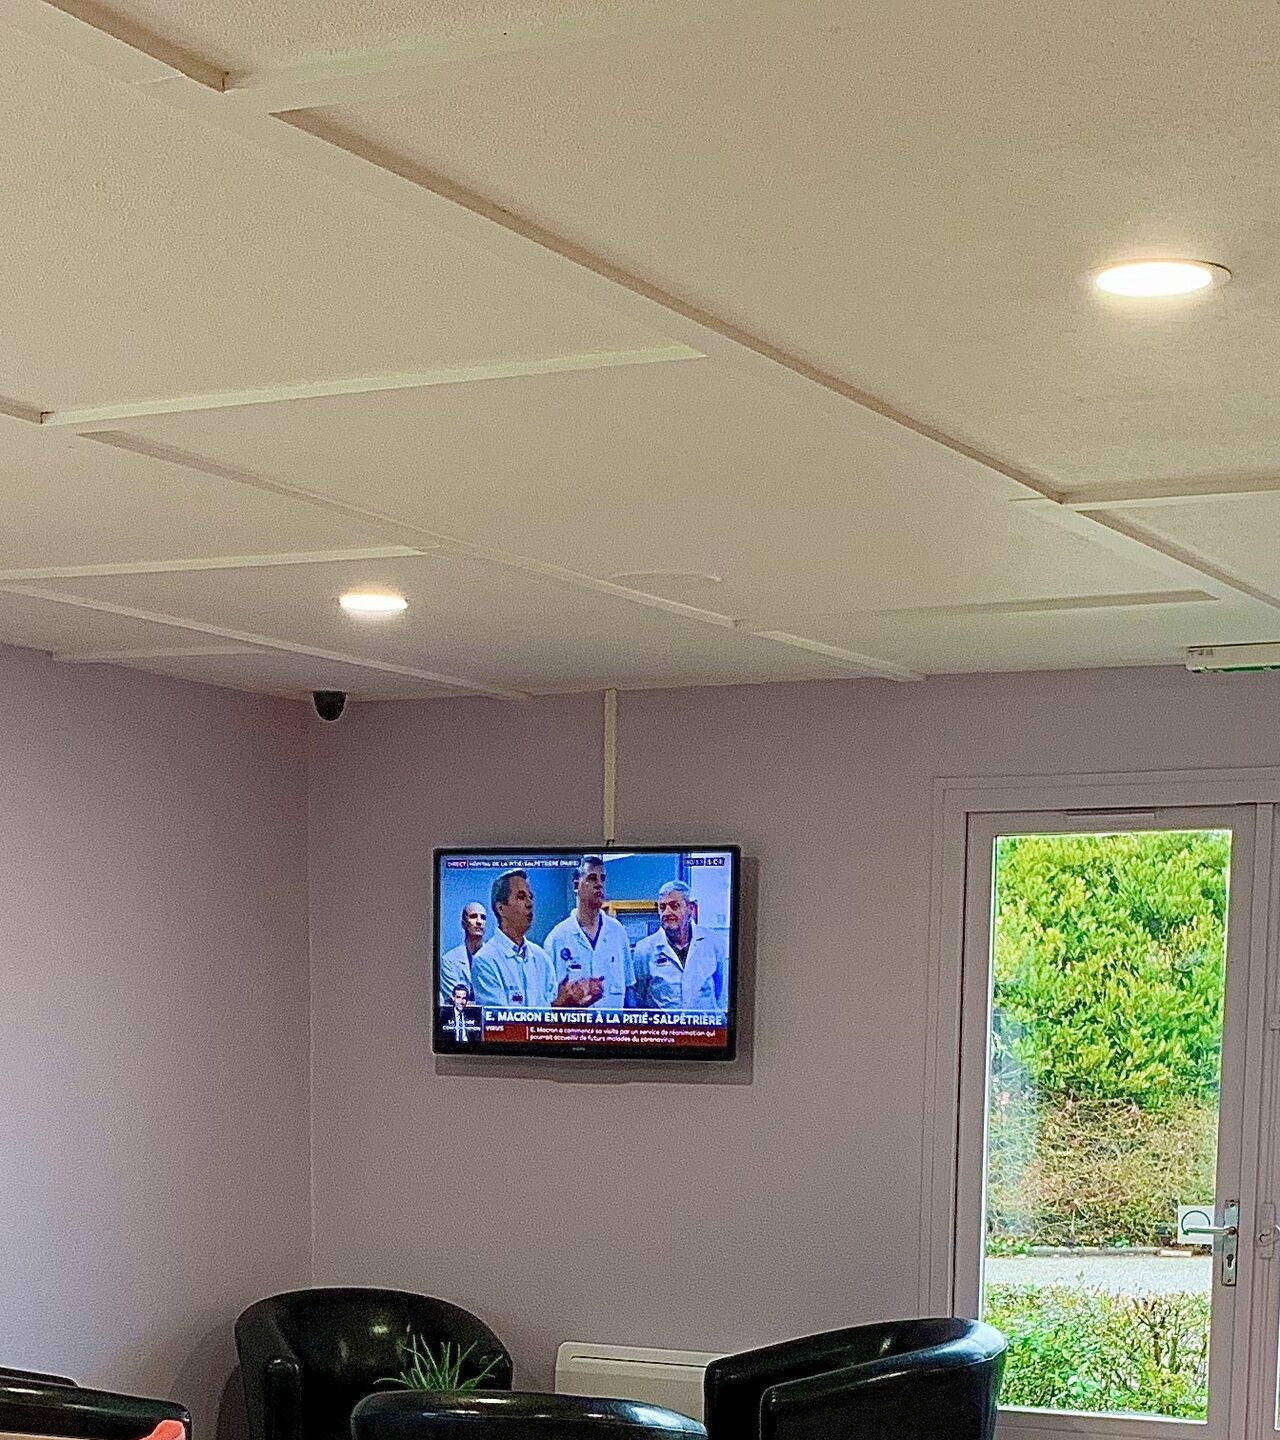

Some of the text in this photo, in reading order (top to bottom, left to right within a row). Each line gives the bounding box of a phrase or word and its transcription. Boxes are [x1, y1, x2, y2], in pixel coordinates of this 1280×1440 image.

[485, 1010, 722, 1026] E. MACRON EN VISITE À LA PITIÉ-SALPÊTRIÈRE
